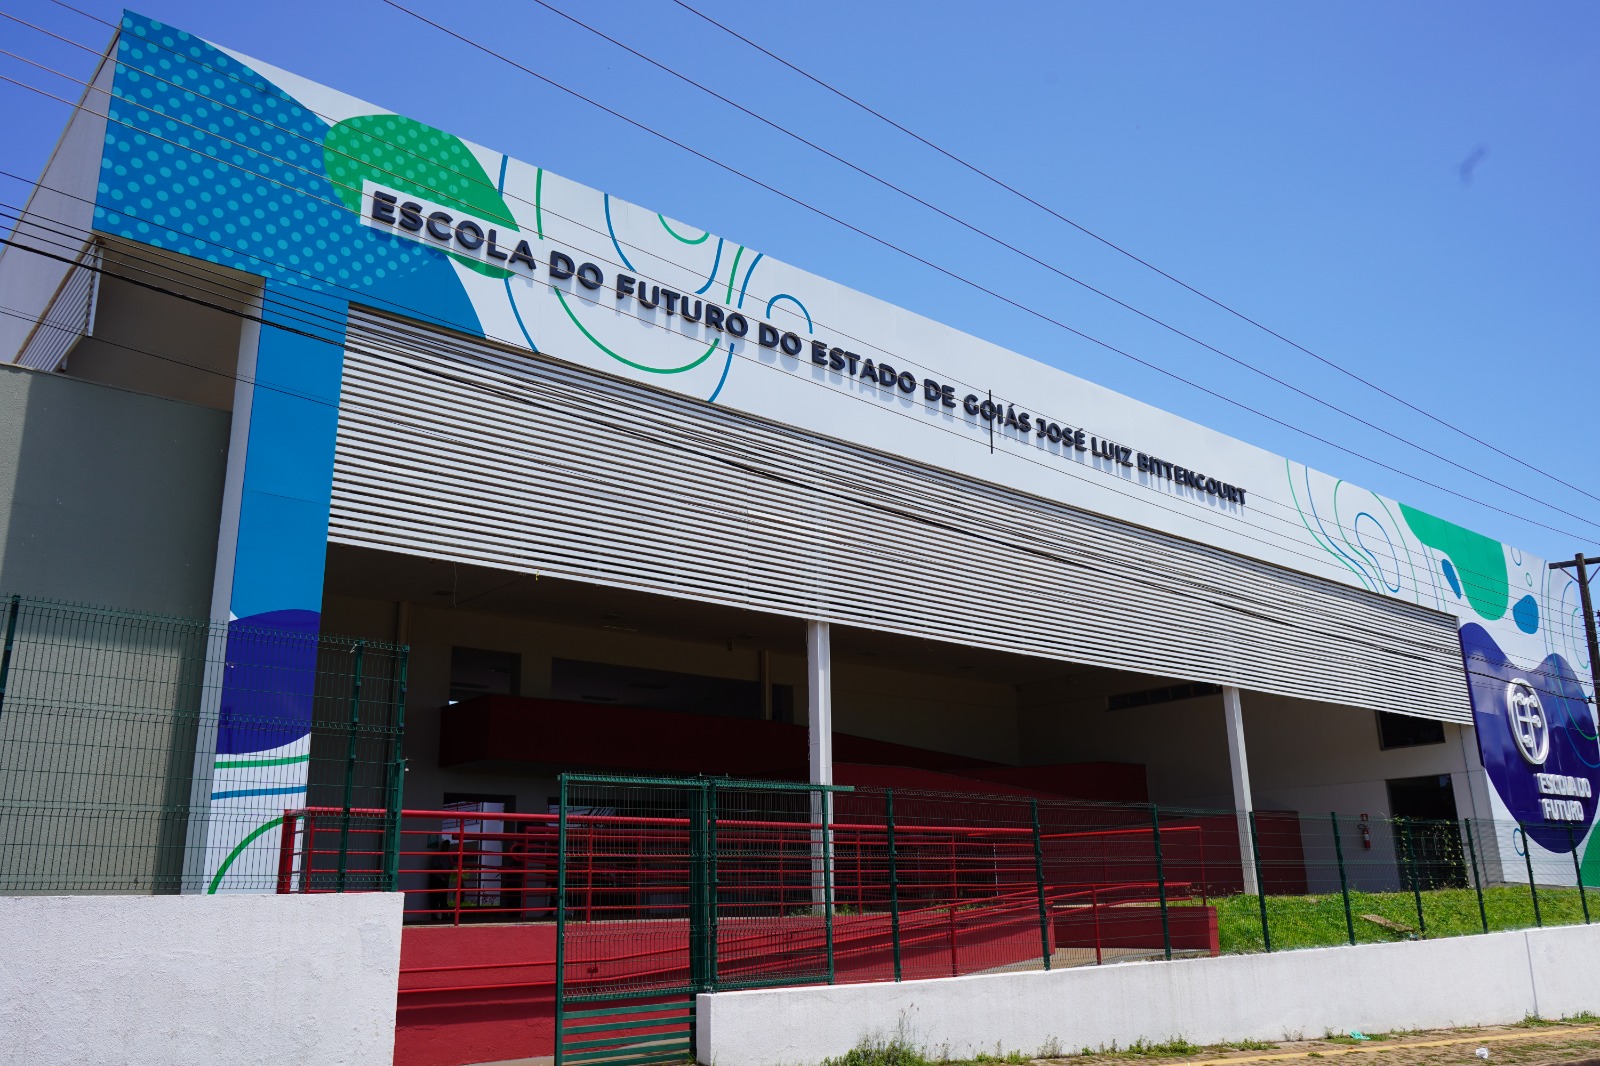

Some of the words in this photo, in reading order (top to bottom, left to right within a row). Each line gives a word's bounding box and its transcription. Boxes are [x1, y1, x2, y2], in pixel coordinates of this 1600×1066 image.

[372, 190, 536, 270] ESCOLA
[549, 250, 604, 290] DO
[616, 273, 749, 338] FUTURO
[758, 321, 802, 356] DO
[811, 339, 917, 394] ESTADO
[924, 378, 957, 408] DE
[963, 394, 1032, 433] GOIÁS
[1036, 417, 1087, 452] JOSÉ
[1091, 436, 1133, 467] LUIZ
[1137, 451, 1246, 505] BITTENCOURT
[1537, 773, 1577, 796] ESCOLA
[1577, 778, 1592, 798] DO
[1541, 799, 1585, 821] FUTURO
